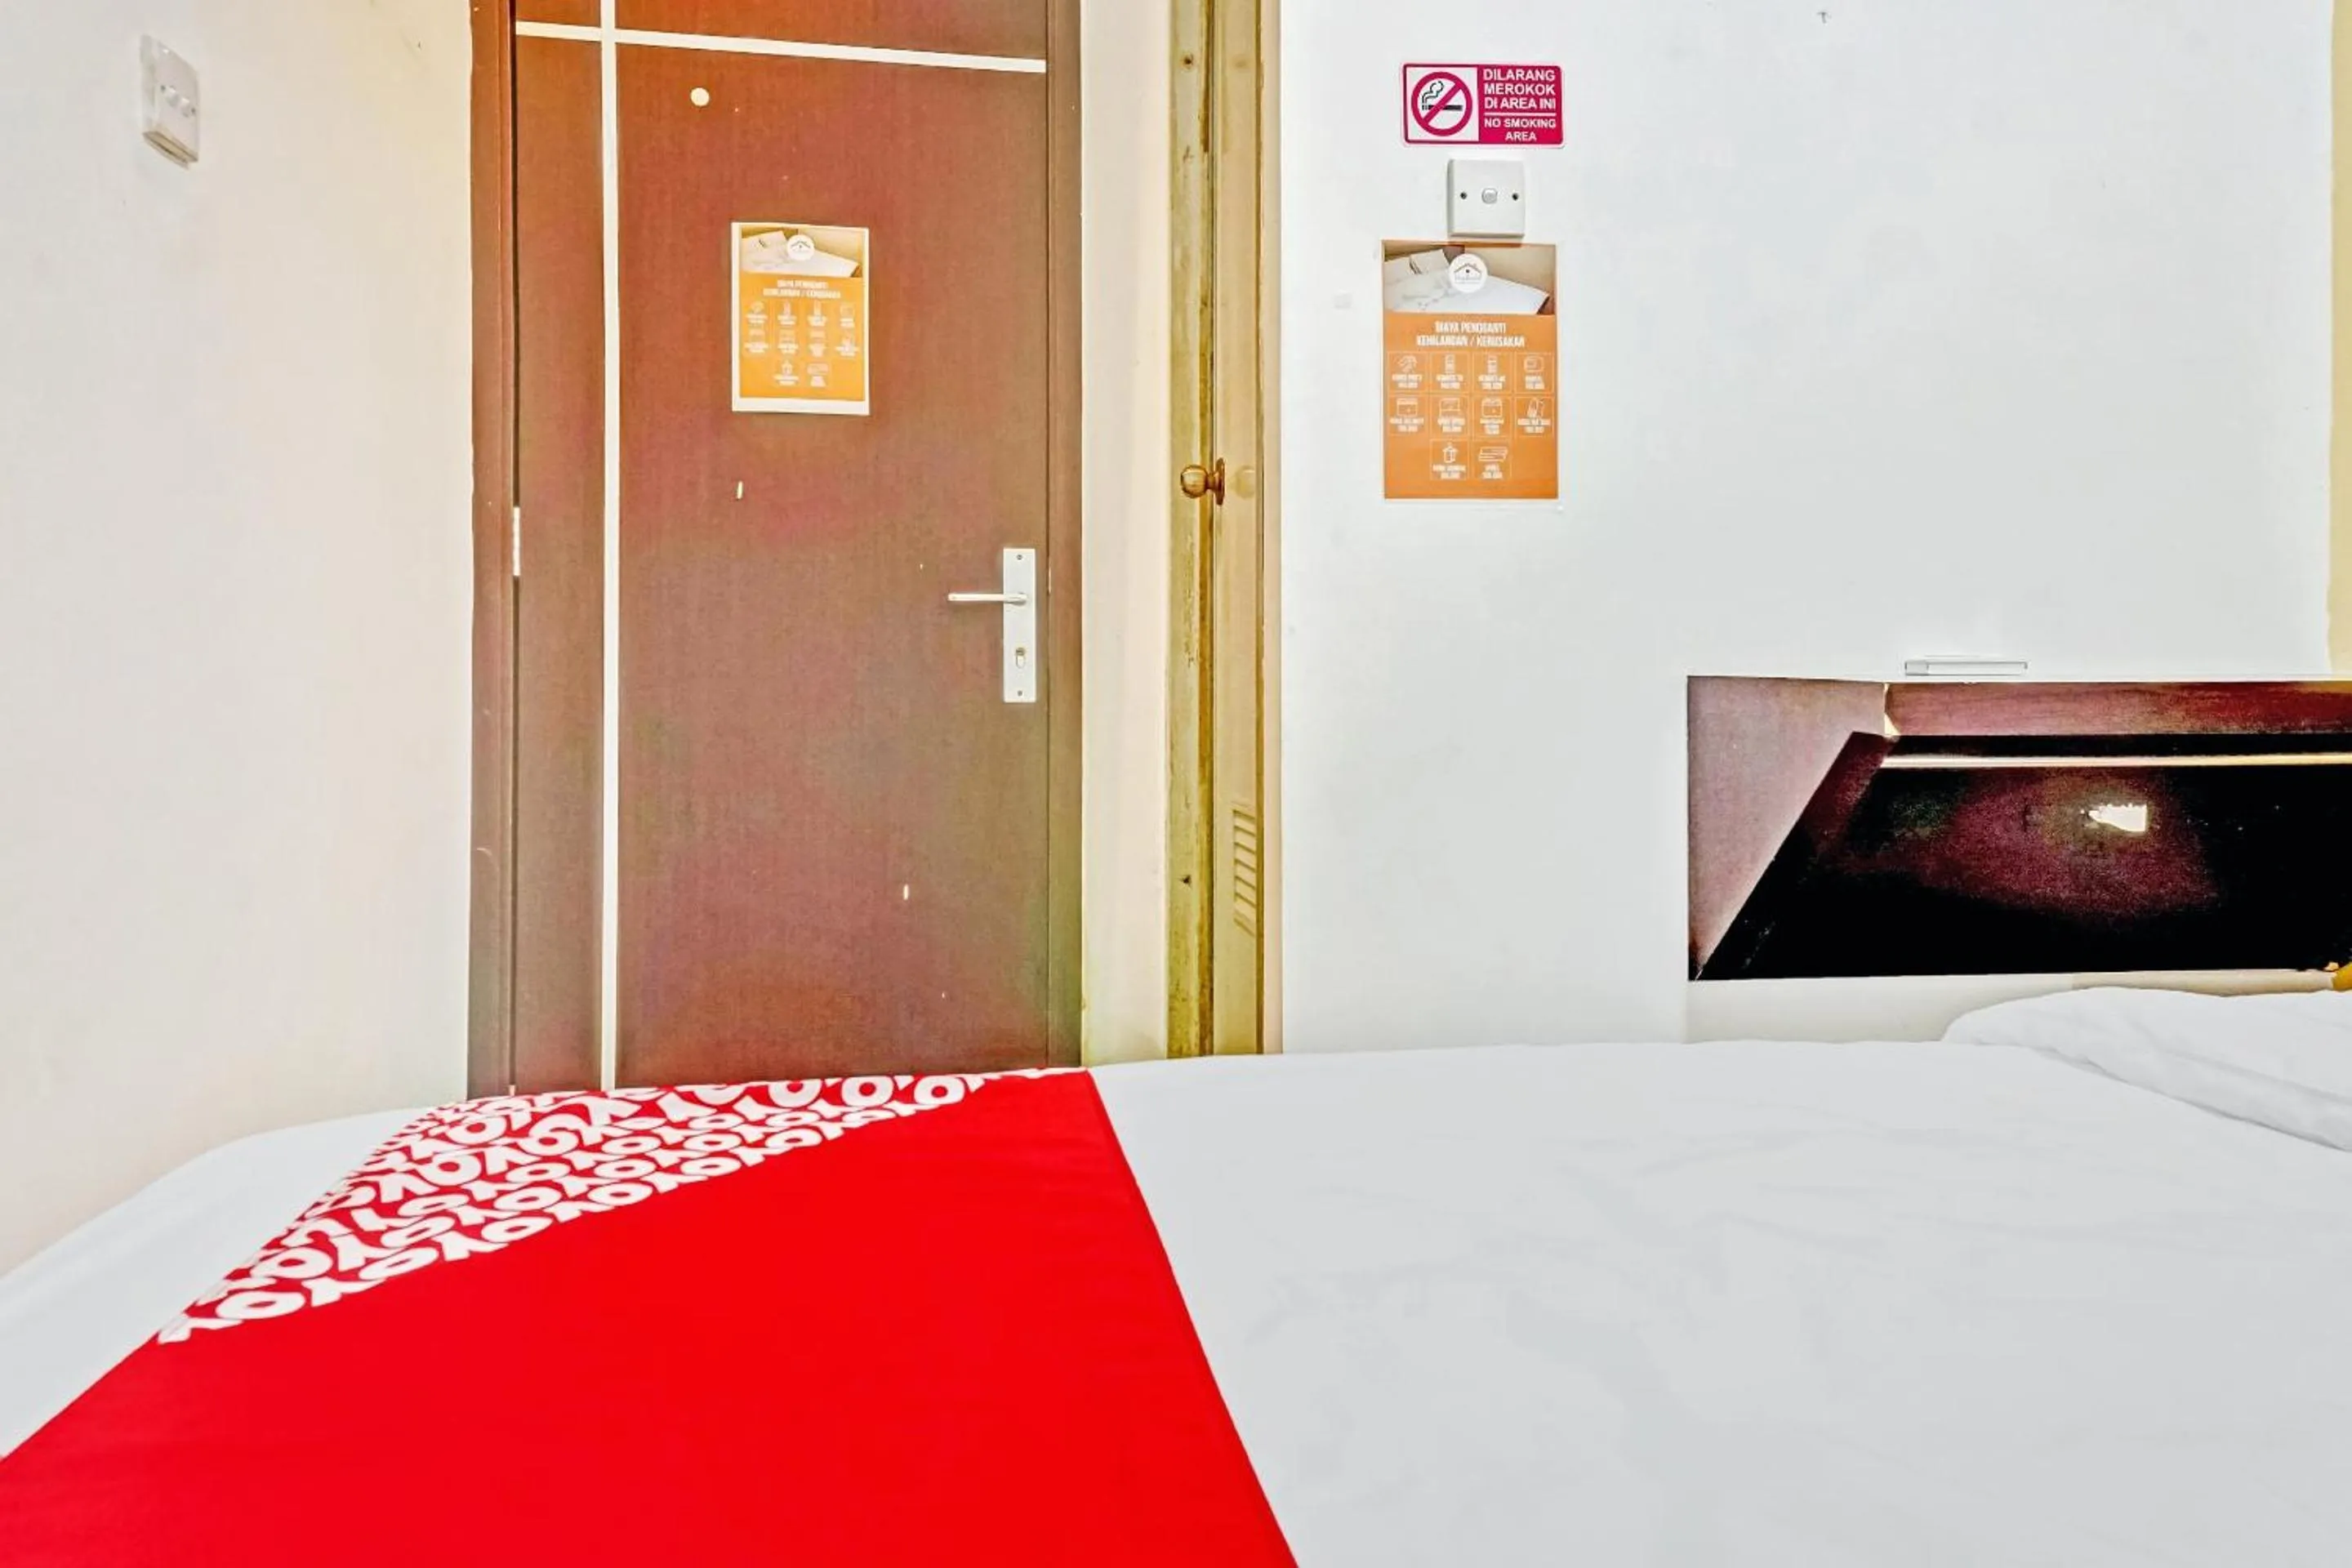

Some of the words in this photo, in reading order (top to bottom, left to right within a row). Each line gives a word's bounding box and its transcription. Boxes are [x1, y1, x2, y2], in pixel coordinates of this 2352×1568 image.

[1483, 68, 1555, 81] DILARANG
[1484, 82, 1556, 96] MEROKOK
[1484, 97, 1498, 109] DI
[1499, 97, 1537, 109] AREA
[1539, 98, 1556, 109] INI
[1484, 118, 1500, 128] NO
[1503, 118, 1557, 129] SMOKING
[1505, 131, 1537, 141] AREA
